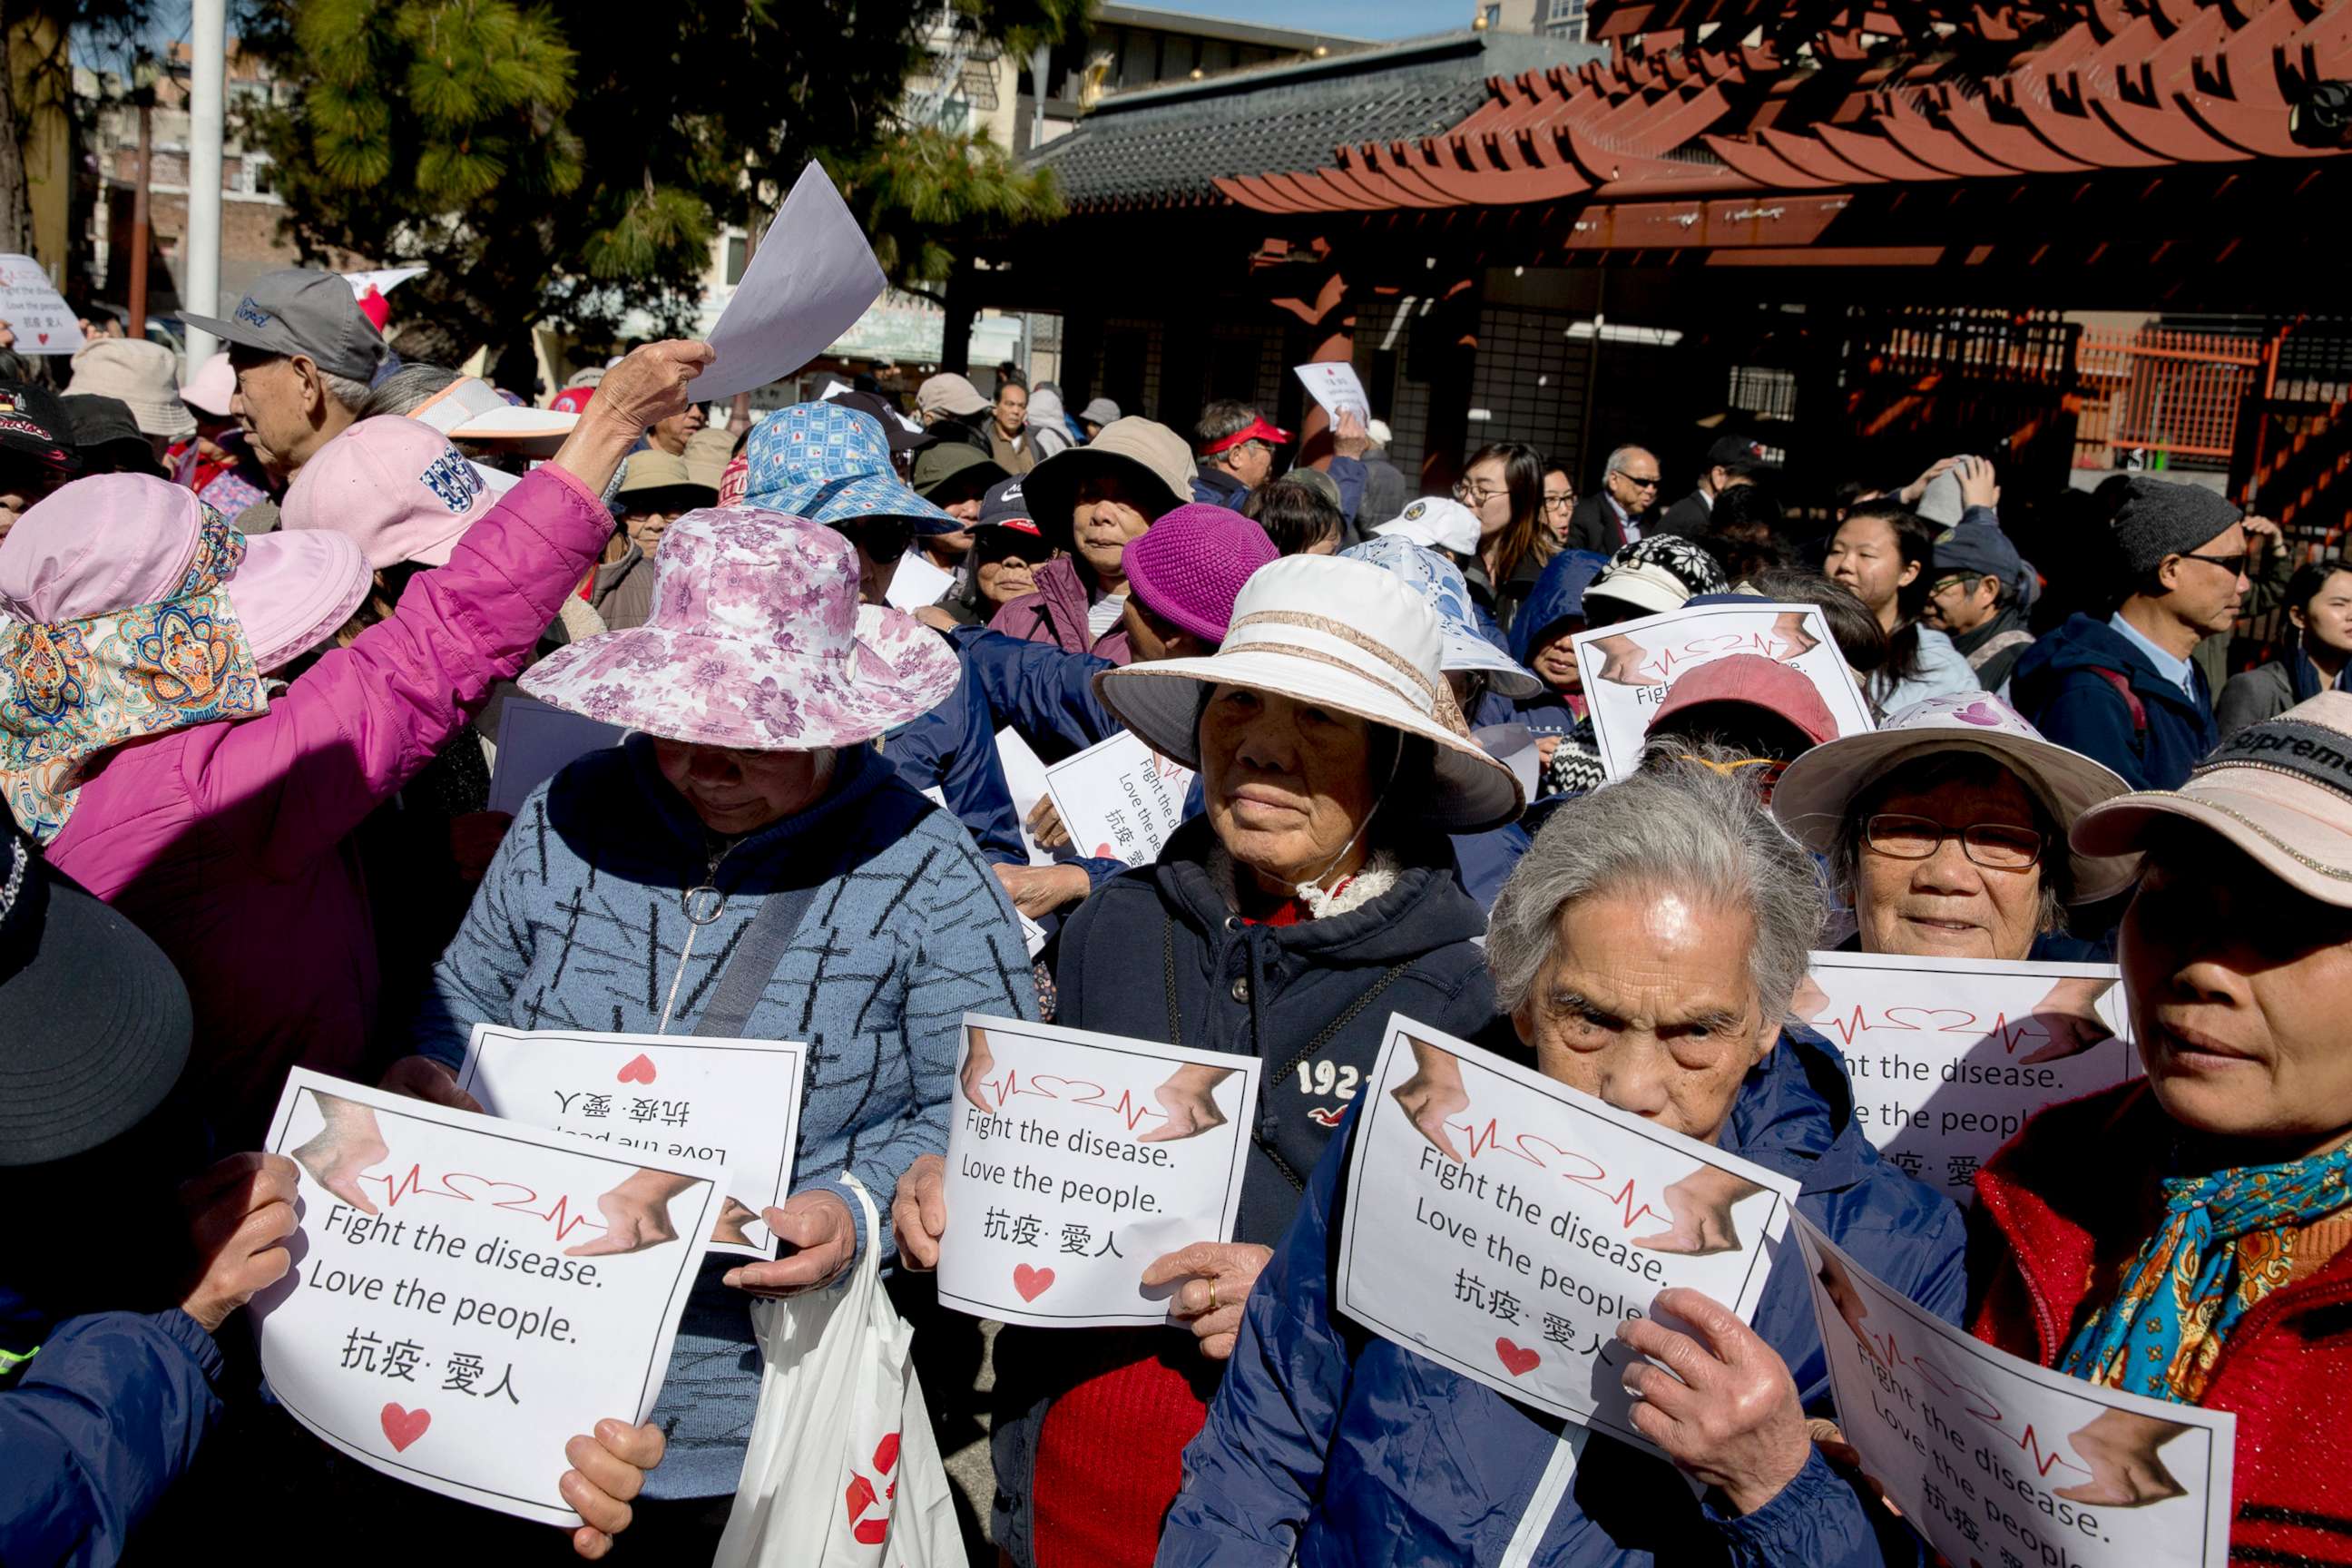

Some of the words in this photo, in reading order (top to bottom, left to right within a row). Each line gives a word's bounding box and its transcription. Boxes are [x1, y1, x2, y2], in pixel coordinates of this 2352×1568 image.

[1119, 773, 1142, 808] Love
[1138, 808, 1155, 833] the
[1140, 758, 1163, 794] Fight
[1158, 794, 1175, 818] the
[1105, 808, 1145, 867] 抗疫·愛
[1297, 1060, 1372, 1100] 192
[1880, 1054, 1929, 1081] the
[1941, 1057, 2063, 1089] disease.
[966, 1108, 1014, 1141] Fight
[1020, 1120, 1059, 1148] the
[1068, 1129, 1175, 1168] disease.
[1879, 1102, 1930, 1129] the
[1942, 1109, 2026, 1139] peopl
[668, 1146, 726, 1165] Love
[962, 1153, 1005, 1184] Love
[1013, 1165, 1053, 1194] the
[1061, 1180, 1162, 1213] people.
[1420, 1146, 1489, 1200] Fight
[1497, 1183, 1542, 1225] the
[1551, 1211, 1668, 1287] disease.
[324, 1205, 407, 1247] Fight
[414, 1222, 466, 1259] the
[475, 1235, 603, 1289] disease.
[1416, 1197, 1477, 1248] Love
[1486, 1233, 1532, 1275] the
[1540, 1265, 1642, 1321] people
[309, 1259, 384, 1300] Love
[393, 1278, 446, 1315] the
[453, 1296, 576, 1344] people.
[1857, 1342, 1916, 1413] Fight
[1922, 1400, 1966, 1454] the
[1975, 1447, 2111, 1544] disease.
[1871, 1389, 1926, 1456] Love
[1932, 1449, 1975, 1502] the
